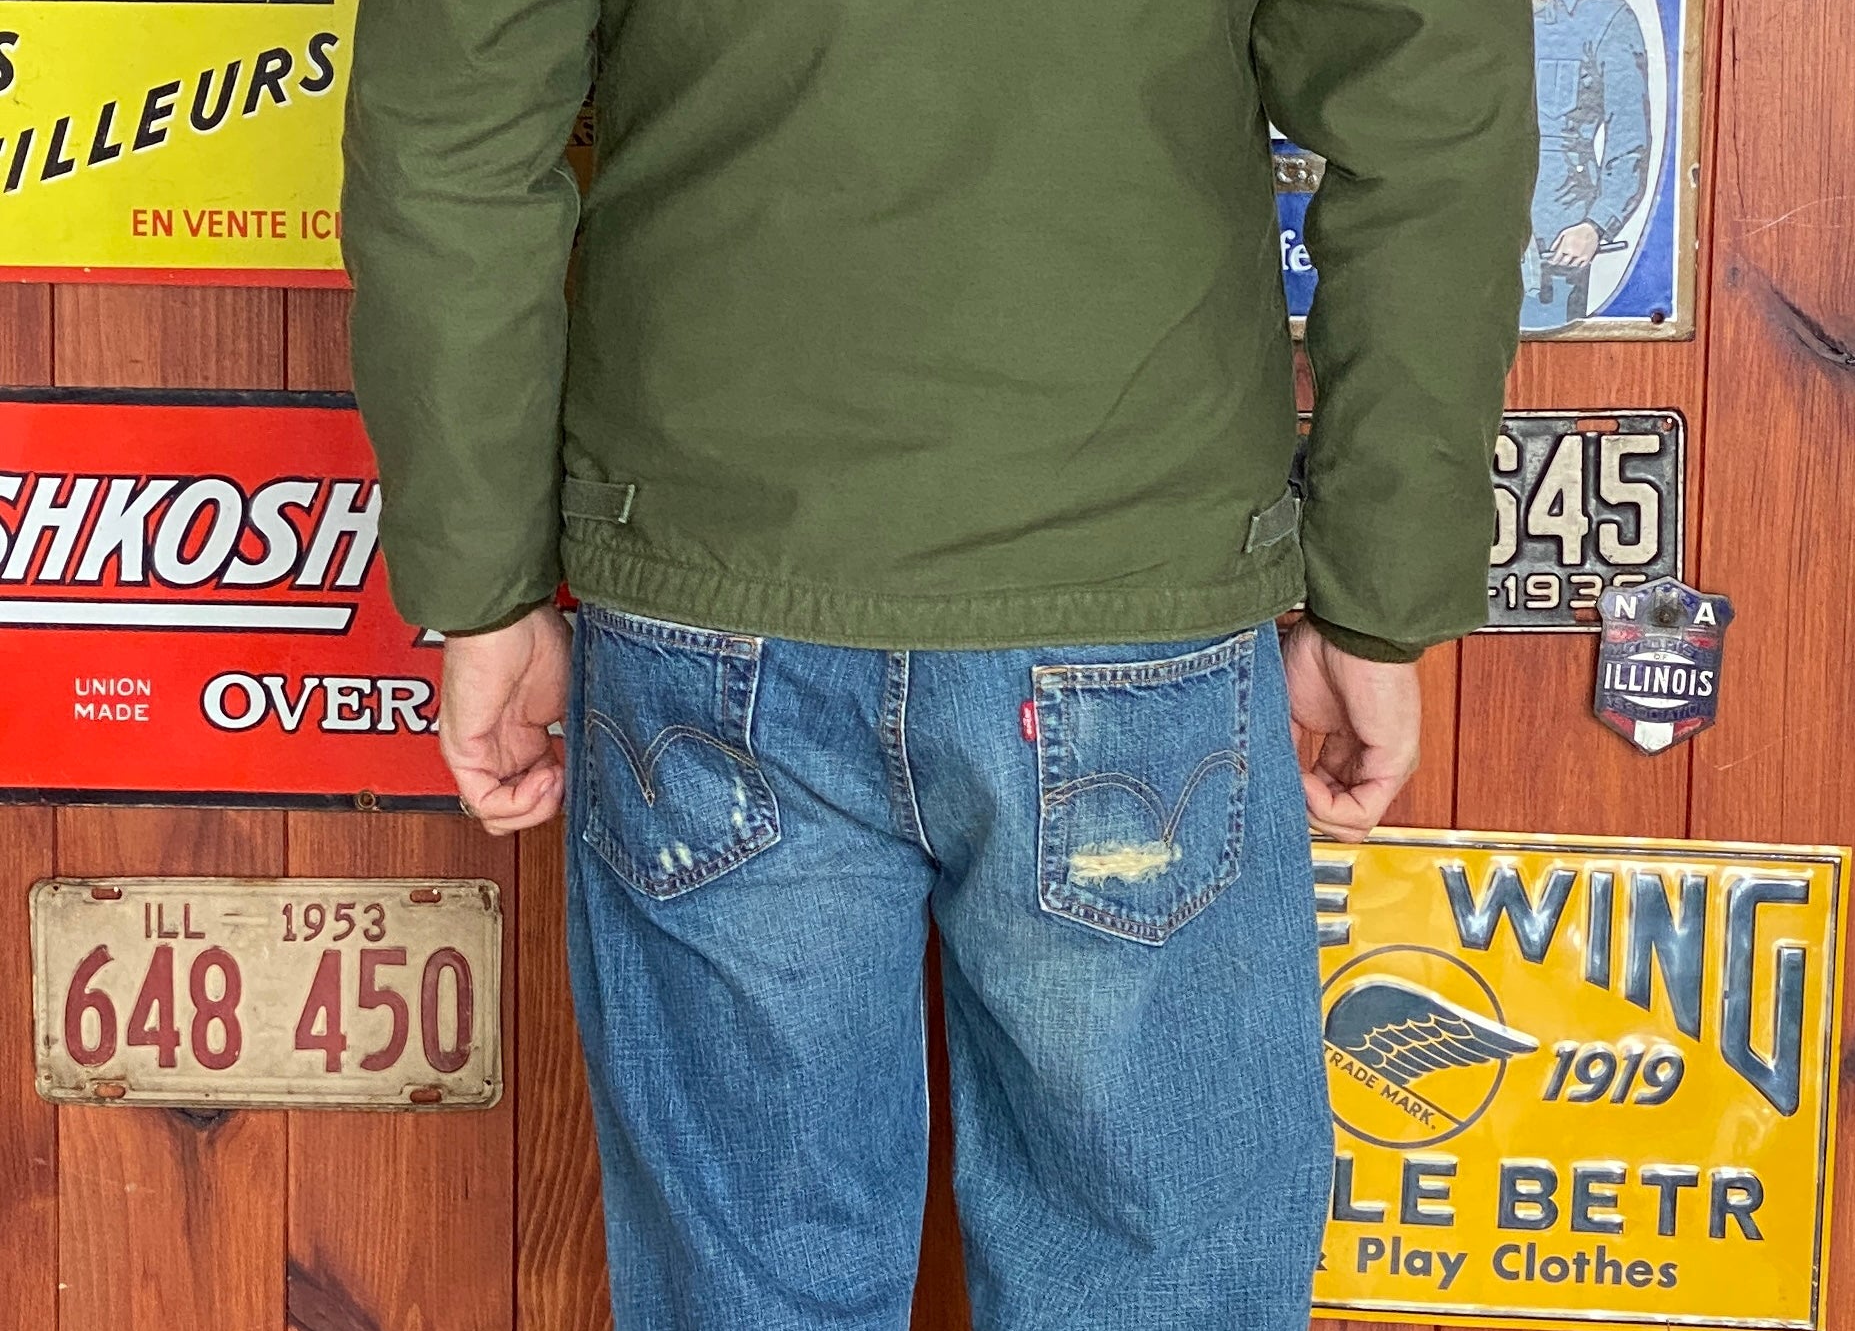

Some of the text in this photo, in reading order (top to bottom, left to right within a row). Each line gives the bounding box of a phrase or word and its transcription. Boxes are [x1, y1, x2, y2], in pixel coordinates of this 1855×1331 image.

[0, 32, 341, 193] ILLEURS
[132, 209, 342, 239] EN VENTE ICI
[1614, 594, 1638, 620] N
[1693, 601, 1717, 626] A
[75, 677, 151, 698] UNION
[203, 672, 440, 732] OVER
[1603, 662, 1714, 698] ILLINOIS
[74, 702, 149, 723] MADE
[144, 902, 206, 940] ILL
[282, 902, 387, 943] 1953
[63, 945, 474, 1073] 648 450
[1438, 859, 1811, 1118] WING
[1540, 1040, 1686, 1107] 1919
[1496, 1157, 1766, 1242] BETR
[1356, 1235, 1469, 1291] Play
[1491, 1243, 1680, 1290] Clothes
